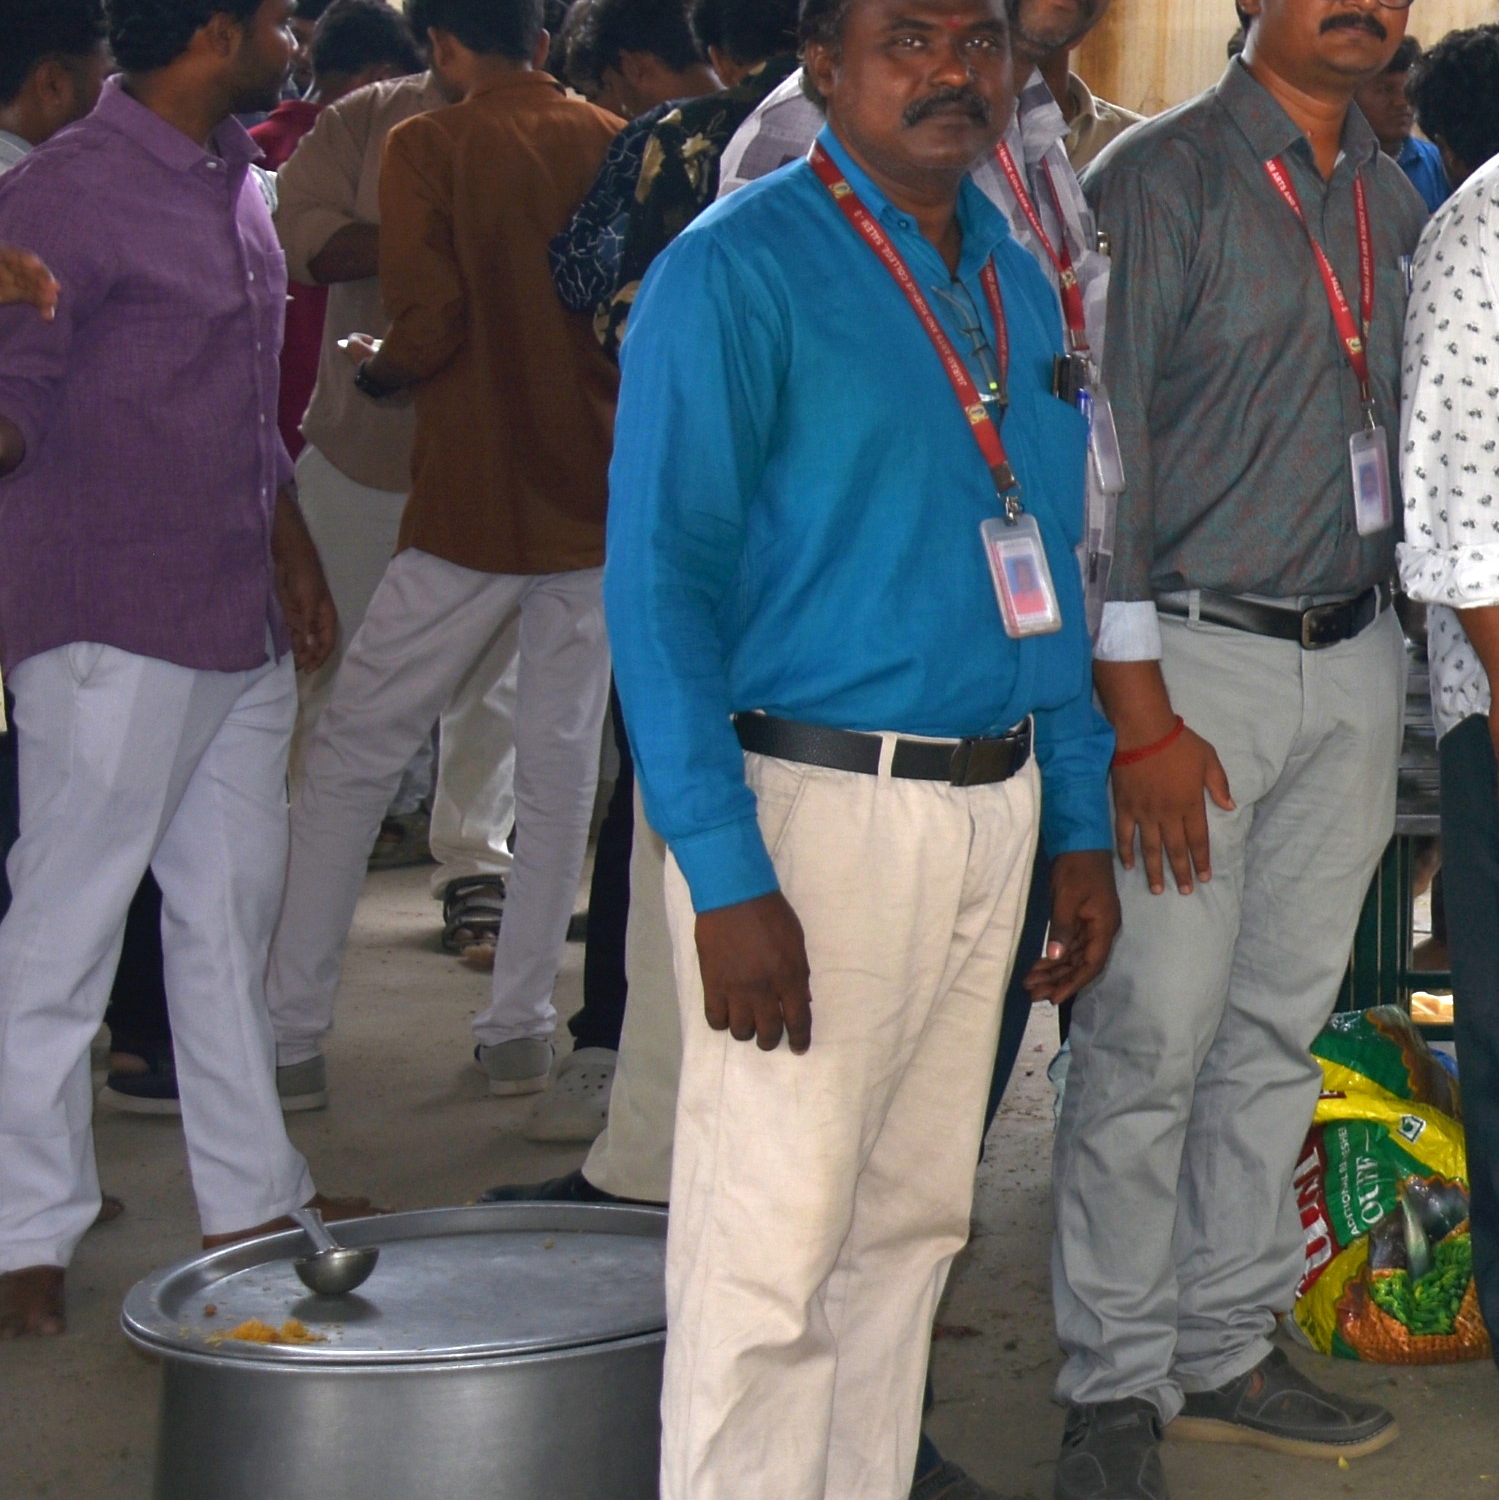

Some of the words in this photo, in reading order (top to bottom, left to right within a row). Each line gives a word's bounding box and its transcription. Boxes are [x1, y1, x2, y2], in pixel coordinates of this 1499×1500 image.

[995, 143, 1013, 173] CIENCE
[1272, 170, 1287, 191] ARTS
[860, 219, 883, 245] SALEM
[925, 315, 938, 334] AND
[935, 333, 950, 355] ARTS
[946, 355, 968, 387] JAIRAM
